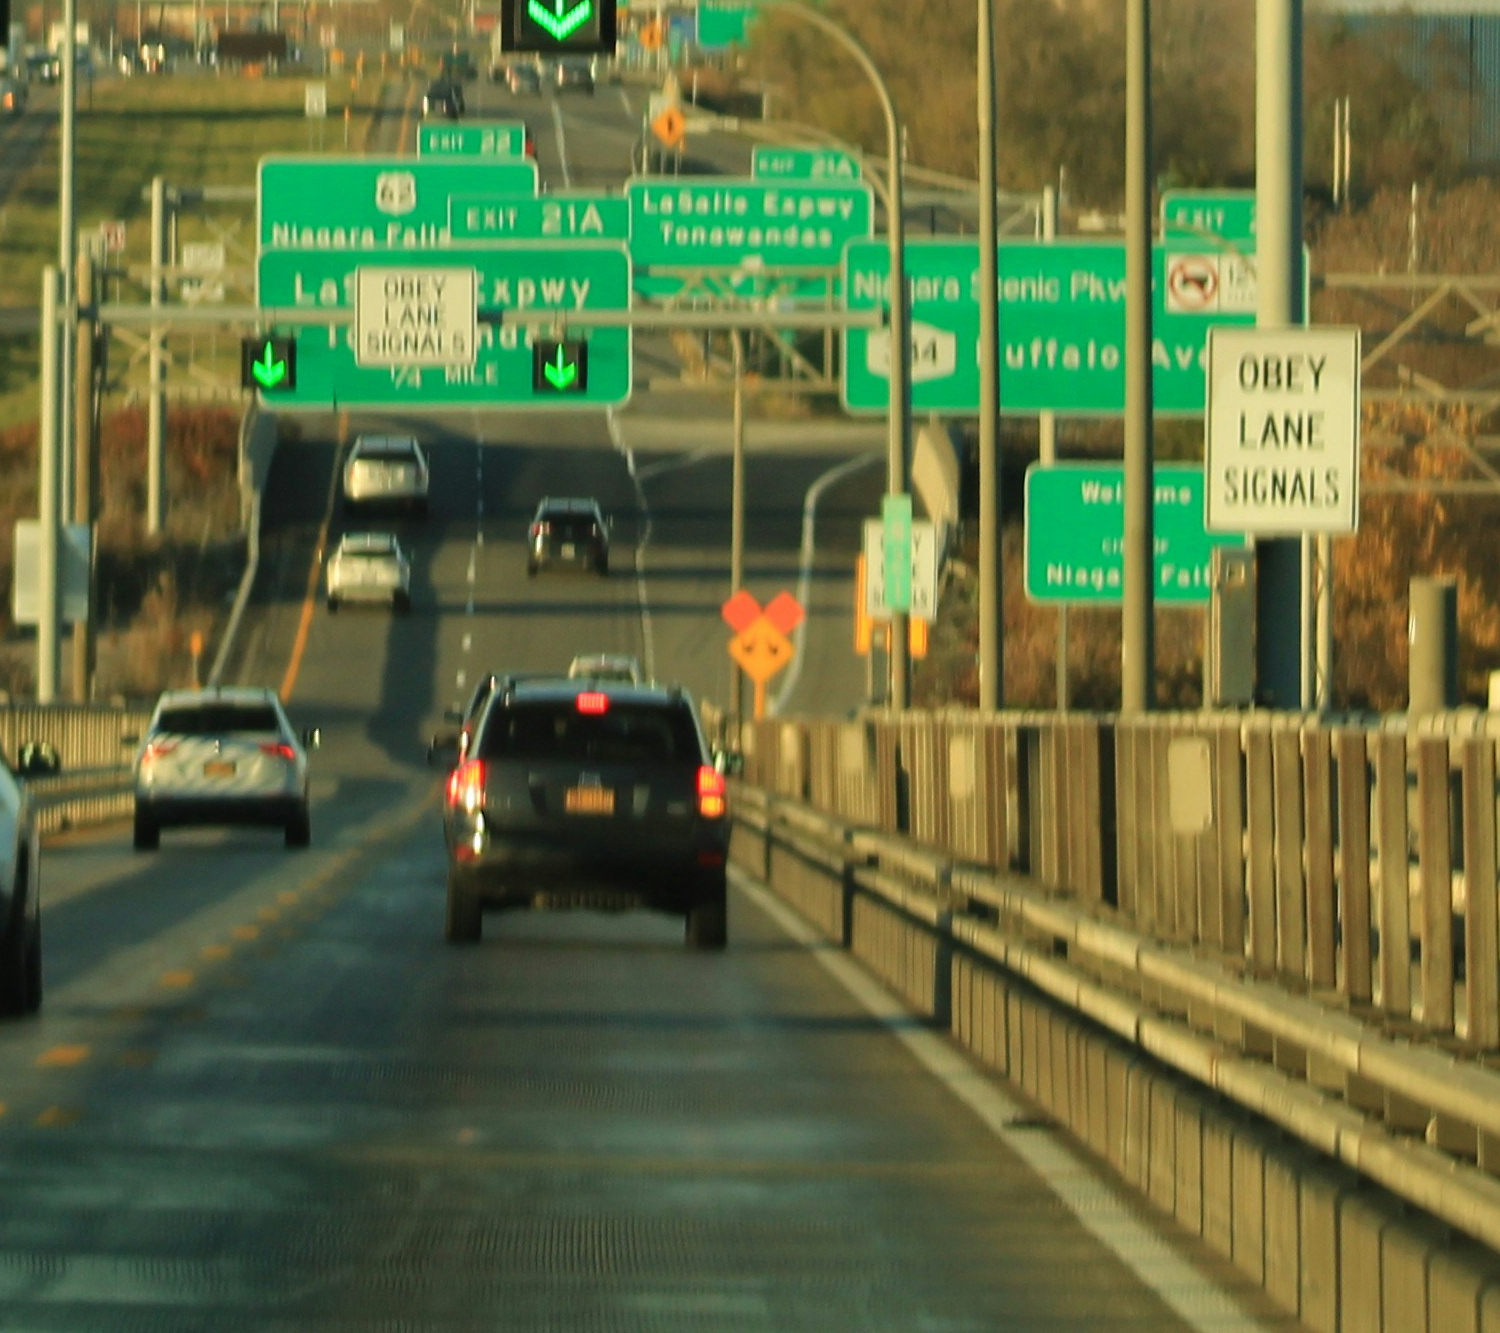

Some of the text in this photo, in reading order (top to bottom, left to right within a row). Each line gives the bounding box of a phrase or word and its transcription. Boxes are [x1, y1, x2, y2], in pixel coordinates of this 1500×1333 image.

[429, 131, 465, 151] EXIT
[466, 202, 604, 234] EXIT 21A
[643, 188, 853, 221] LaSalle Expwy
[1175, 206, 1225, 231] EXIT
[384, 274, 447, 302] OBEY
[970, 267, 1060, 303] Senic
[384, 304, 446, 327] LANE
[367, 330, 465, 354] SIGNALS
[976, 336, 1119, 371] uffalo
[445, 362, 498, 386] MILE
[1238, 353, 1326, 393] OBEY
[1239, 410, 1326, 450] LANE
[1081, 480, 1192, 506] Welme
[1224, 466, 1339, 508] SIGNALS
[1046, 562, 1120, 592] Niaga
